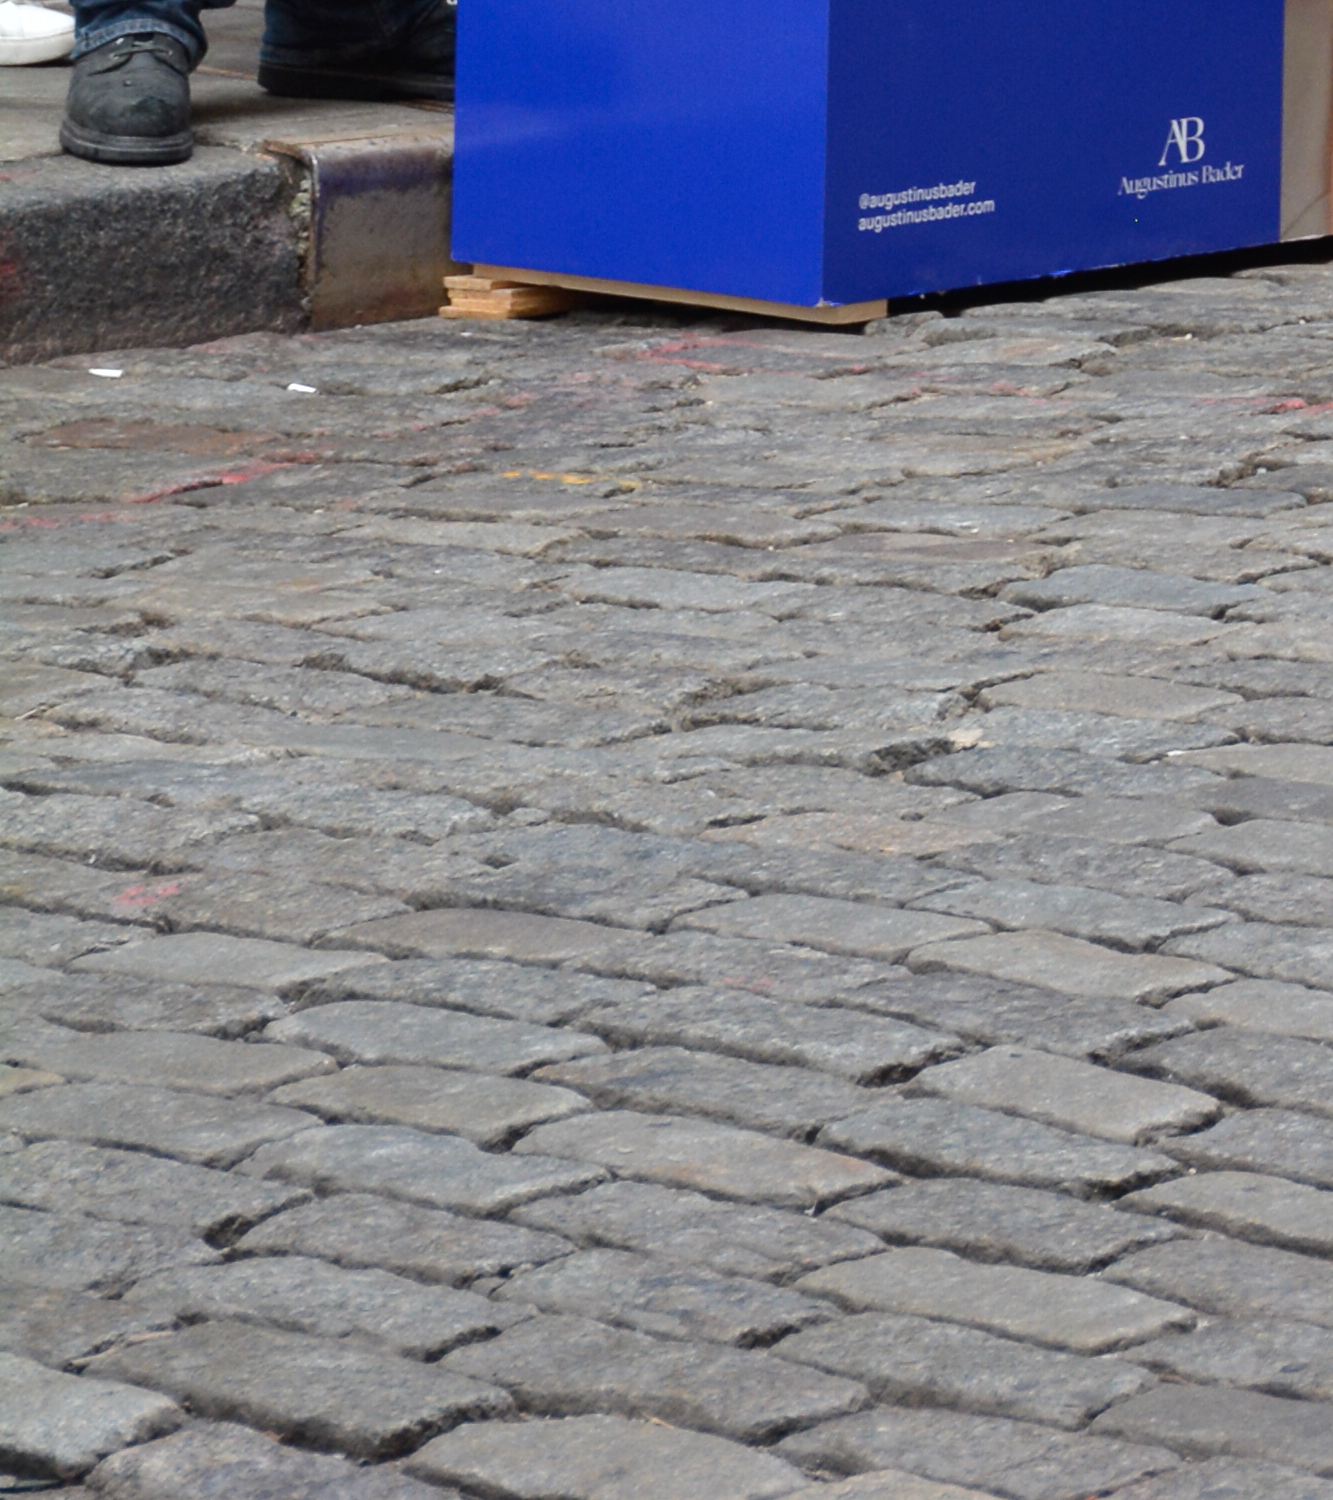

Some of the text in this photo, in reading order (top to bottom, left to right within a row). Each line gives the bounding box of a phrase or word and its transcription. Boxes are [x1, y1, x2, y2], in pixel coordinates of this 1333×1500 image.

[1158, 116, 1206, 167] AB
[858, 179, 977, 211] @augustinusbader
[1117, 161, 1245, 200] Augustinus Bader
[857, 198, 996, 234] augustinusbader.com
